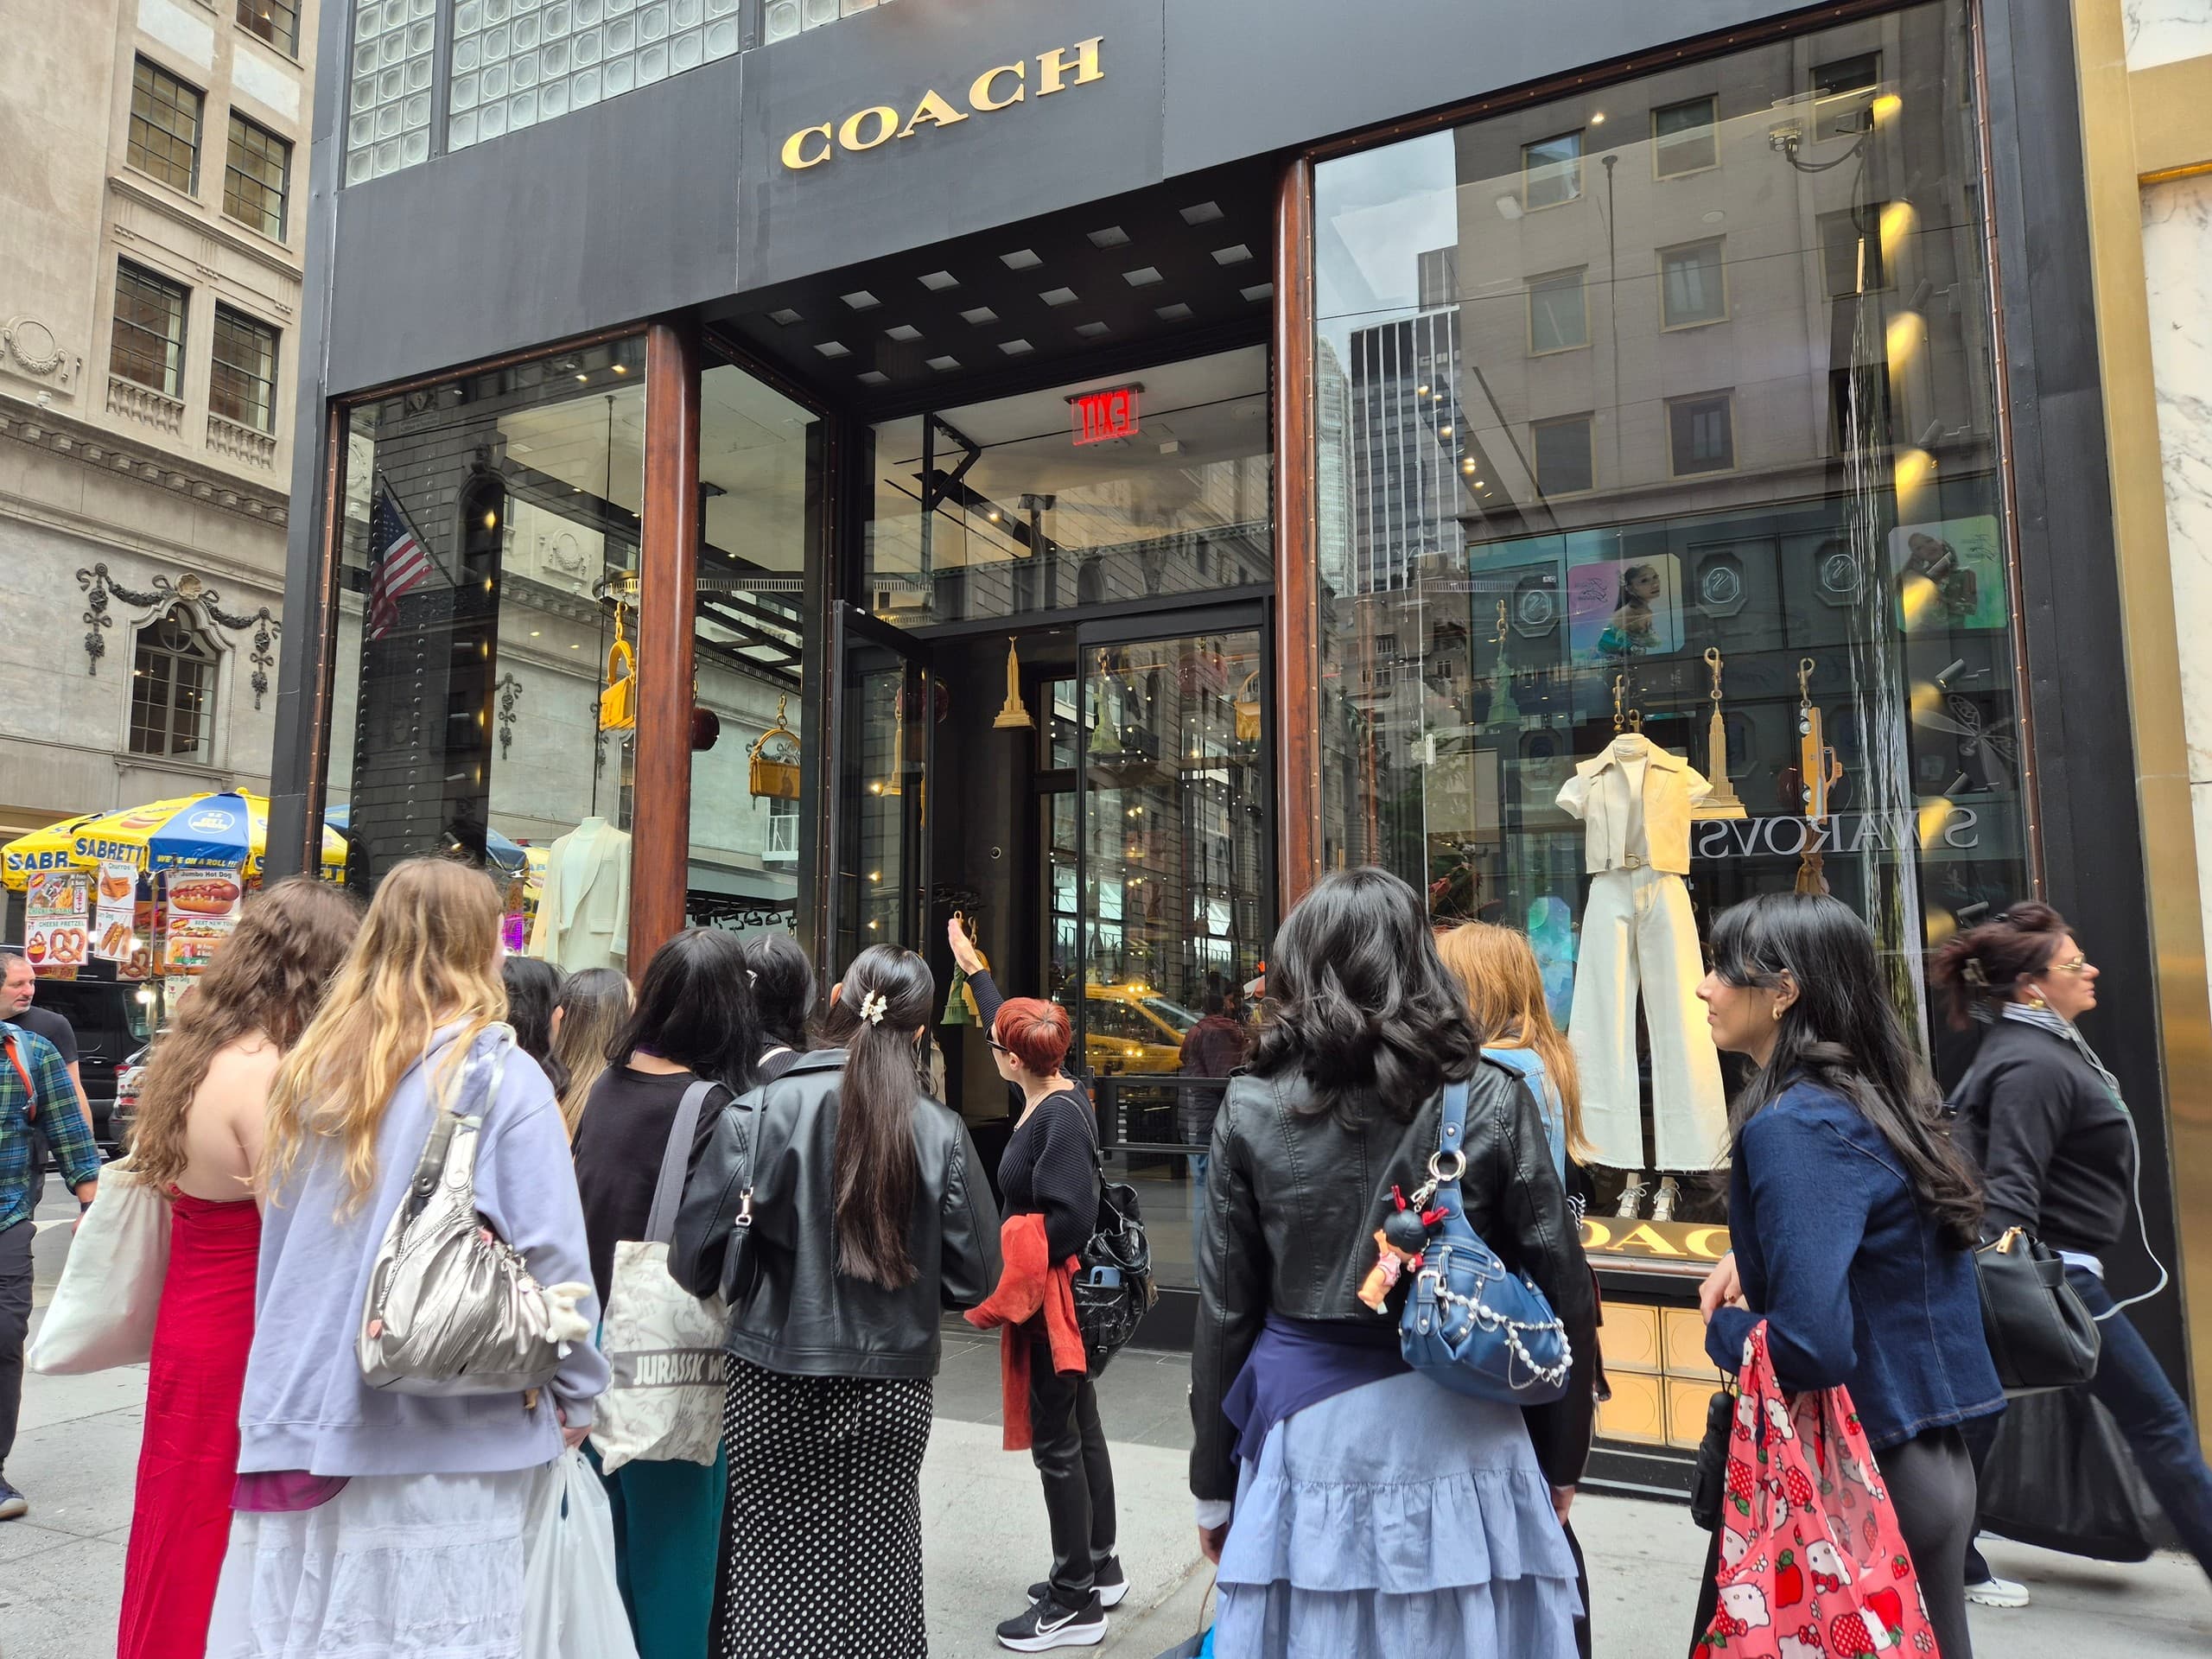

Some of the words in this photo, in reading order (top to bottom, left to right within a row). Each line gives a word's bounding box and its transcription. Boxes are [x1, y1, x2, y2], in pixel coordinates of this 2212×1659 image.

[781, 35, 1104, 170] COACH
[8, 851, 69, 870] SABR
[75, 837, 143, 862] SABRETT
[1581, 1219, 1730, 1259] OAC
[633, 1353, 705, 1386] JURASSIC
